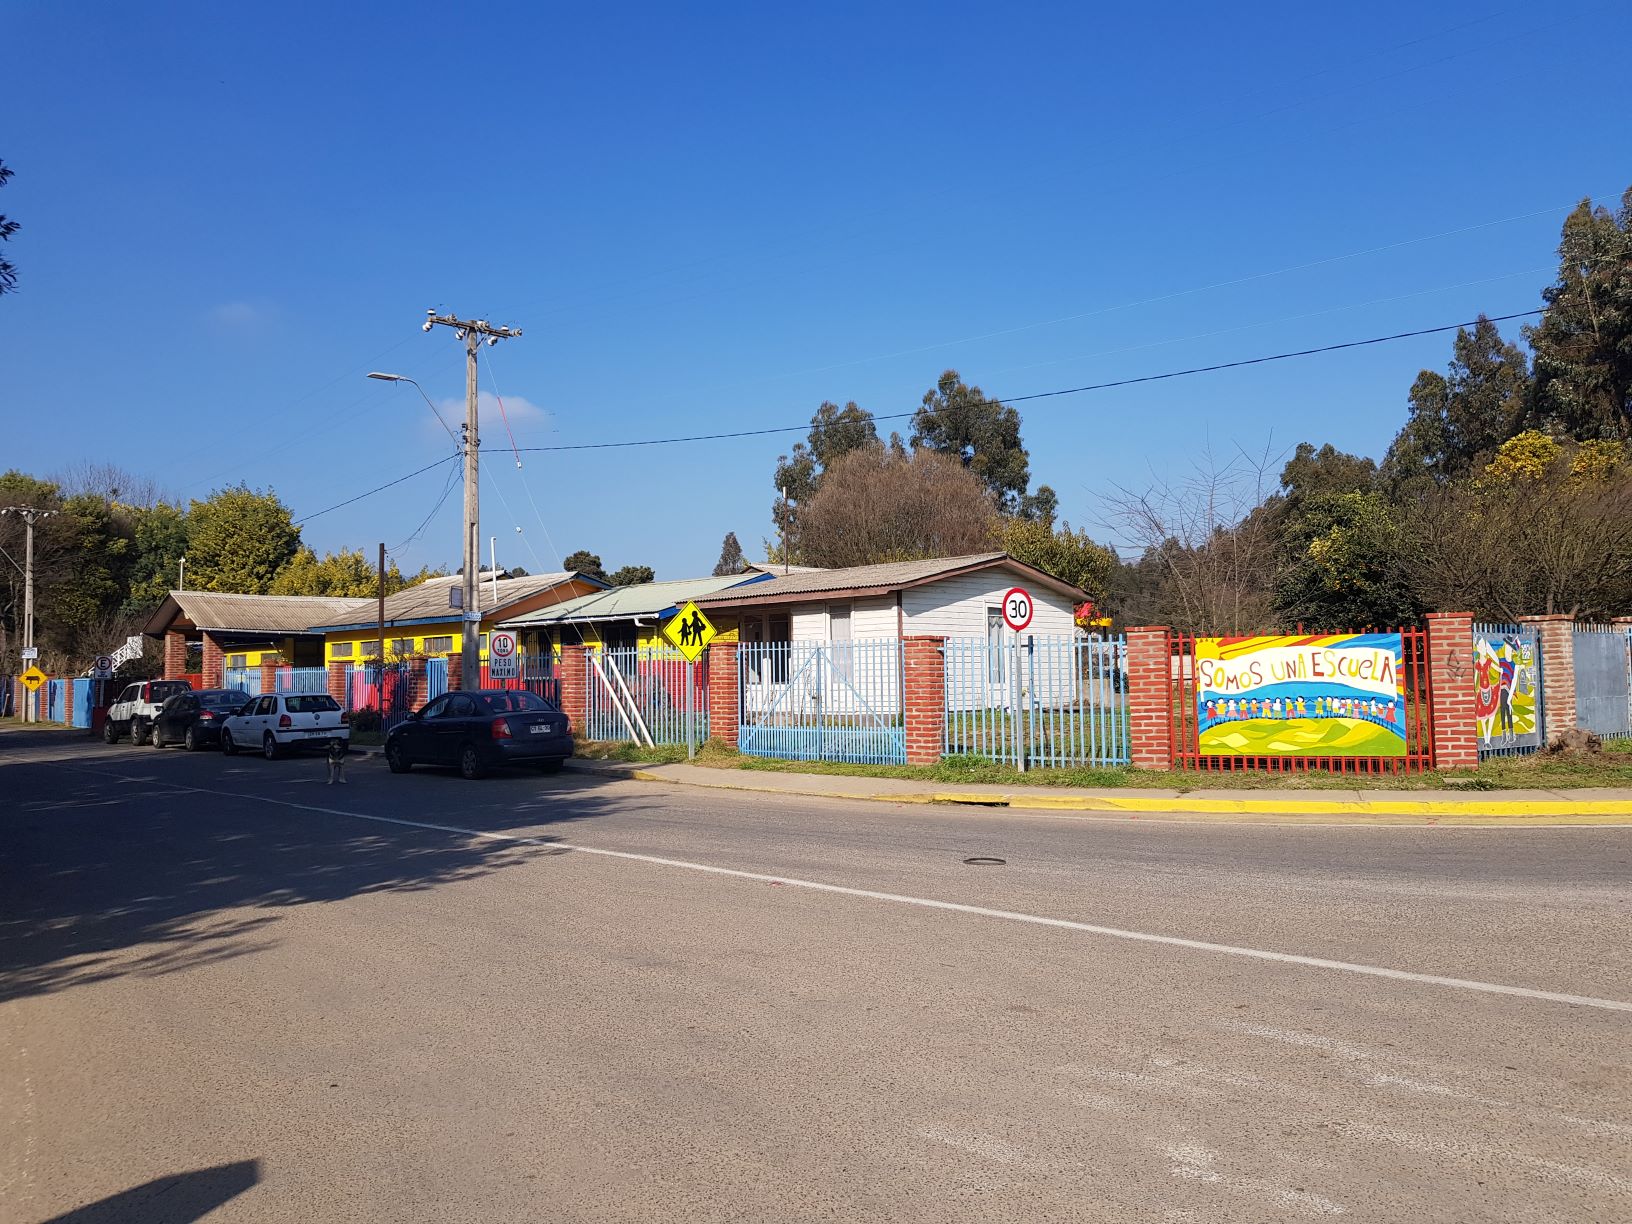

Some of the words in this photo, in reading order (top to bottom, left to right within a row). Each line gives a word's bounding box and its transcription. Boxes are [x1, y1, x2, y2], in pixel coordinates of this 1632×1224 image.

[1009, 600, 1027, 618] 30
[498, 638, 508, 648] 10
[100, 659, 107, 668] E
[494, 658, 512, 667] PESO
[491, 668, 516, 677] MAXIMO
[1200, 660, 1263, 690] SOMOS
[1271, 653, 1307, 681] UNA
